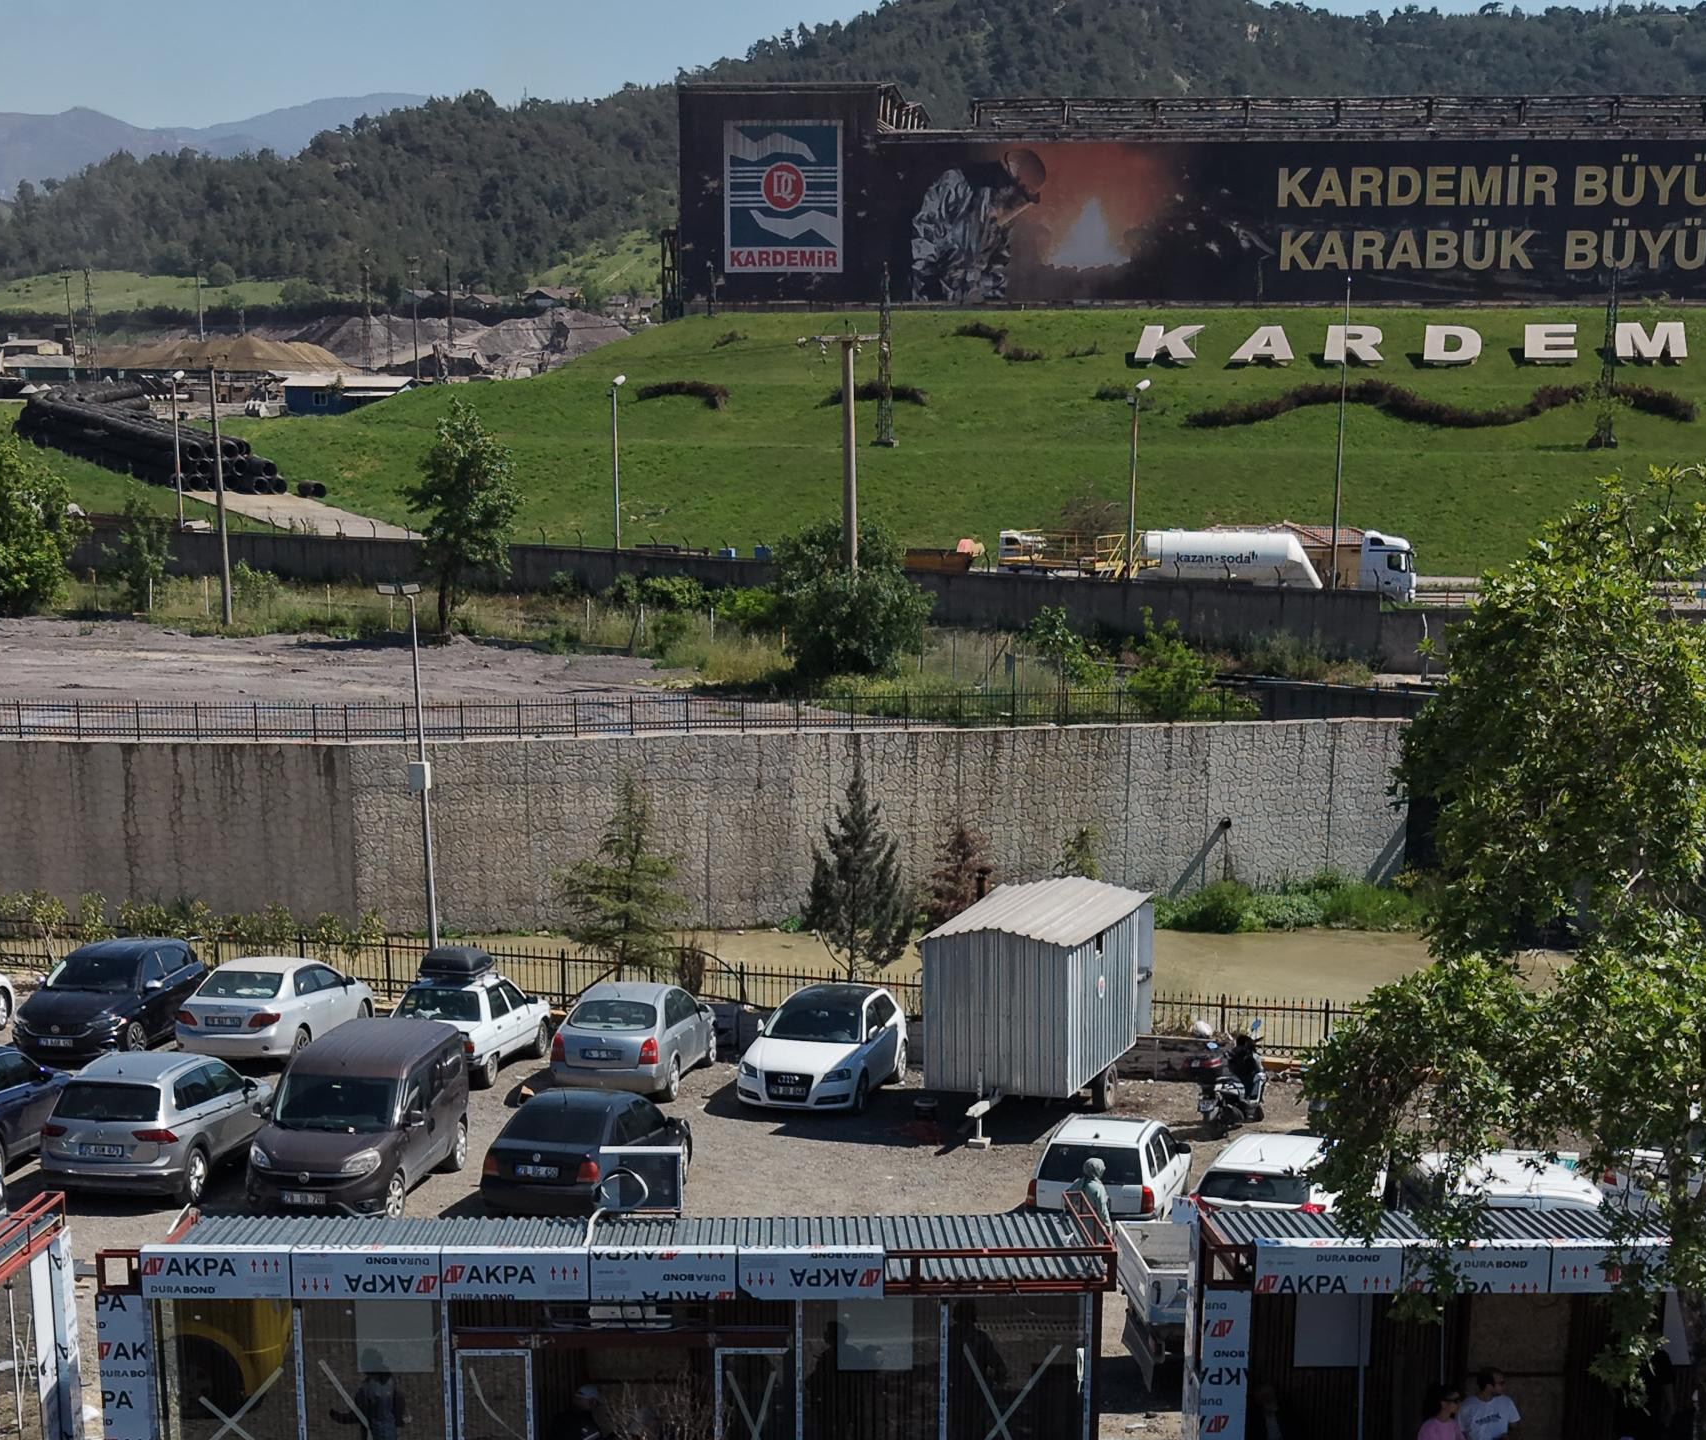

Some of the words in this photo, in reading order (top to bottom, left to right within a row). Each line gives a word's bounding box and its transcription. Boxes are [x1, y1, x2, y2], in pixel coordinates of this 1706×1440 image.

[1277, 154, 1558, 208] KARDEMİR
[1279, 218, 1536, 272] KARABÜK
[166, 1257, 237, 1277] AKPA
[467, 1265, 536, 1284] AKPA
[345, 1274, 414, 1294] AKPA
[790, 1267, 859, 1288] AKPA
[1279, 1275, 1346, 1294] AKPA
